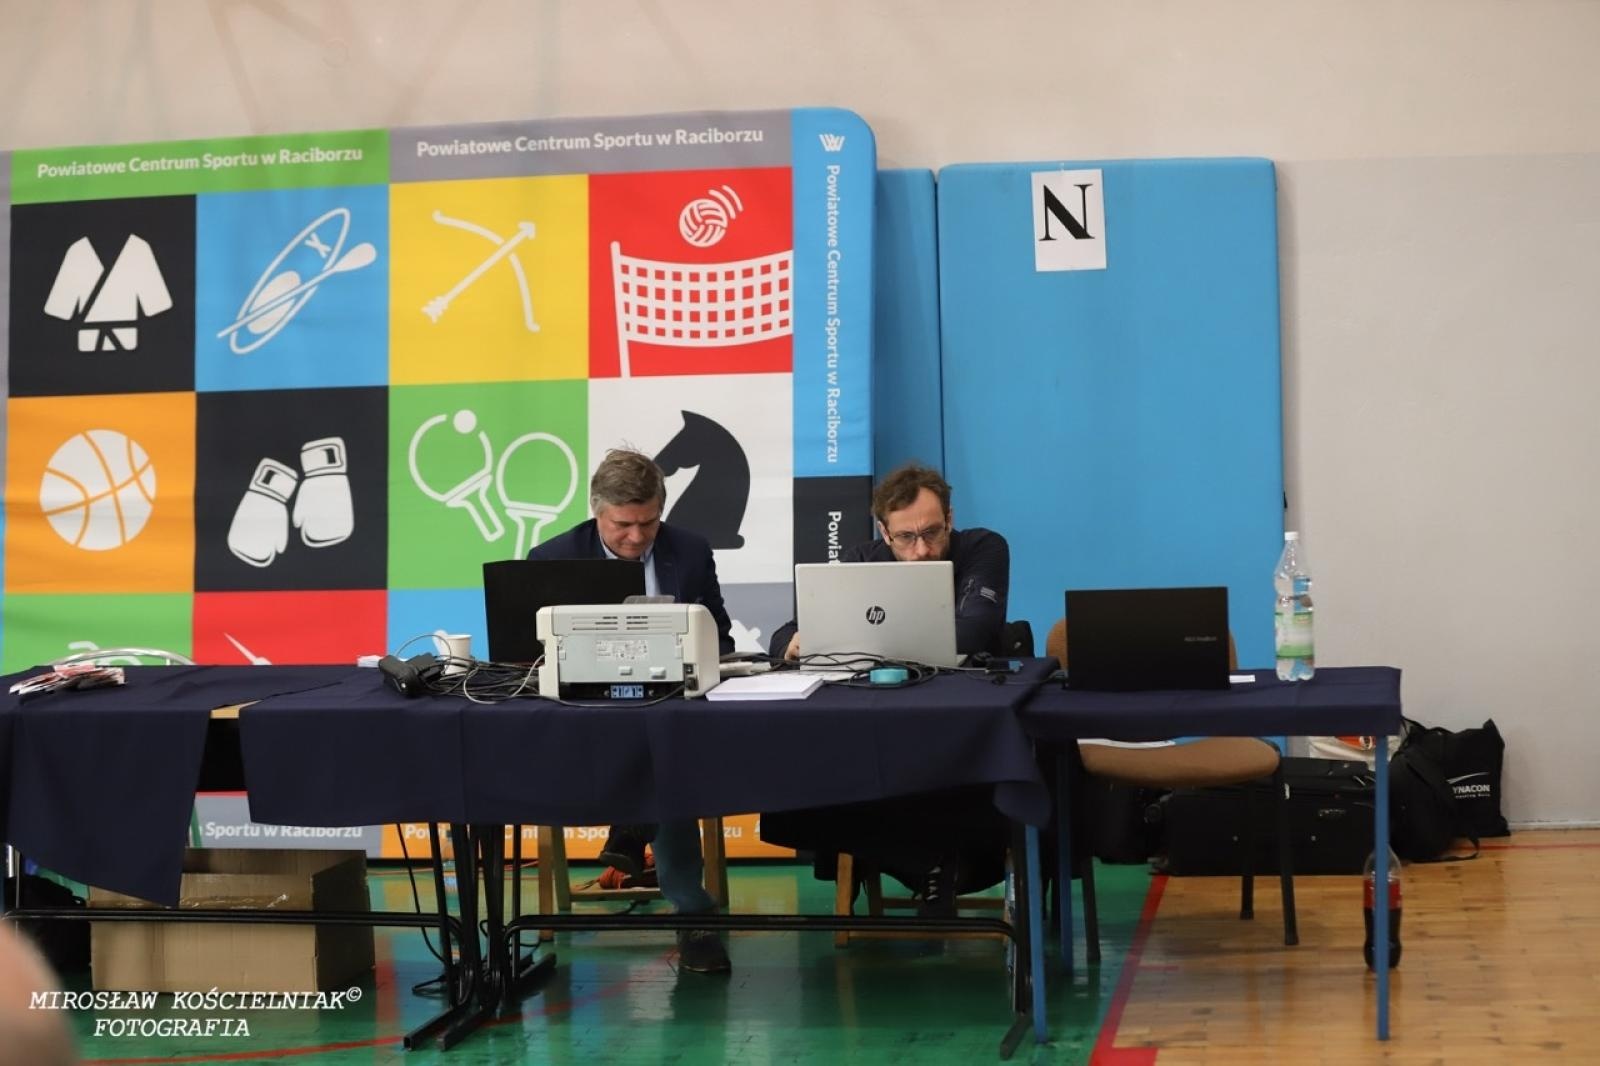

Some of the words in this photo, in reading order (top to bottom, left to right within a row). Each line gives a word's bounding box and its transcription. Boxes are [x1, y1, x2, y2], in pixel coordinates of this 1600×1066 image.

[36, 160, 126, 179] Powiatowe
[128, 156, 200, 173] Centrum
[201, 152, 259, 171] Sportu
[261, 153, 277, 165] w
[279, 146, 363, 165] Raciborzu
[415, 138, 512, 158] Powiatowe
[514, 135, 591, 152] Centrum
[593, 131, 653, 151] Sportu
[655, 133, 672, 146] w
[674, 127, 764, 146] Raciborzu
[826, 164, 842, 247] Powiatowe
[1038, 183, 1096, 242] N
[827, 249, 842, 316] Centrum
[825, 317, 841, 369] Sportu
[827, 371, 838, 385] w
[827, 387, 841, 464] Raciborzu
[867, 605, 886, 625] hp
[205, 821, 260, 840] Sportu
[263, 825, 279, 838] w
